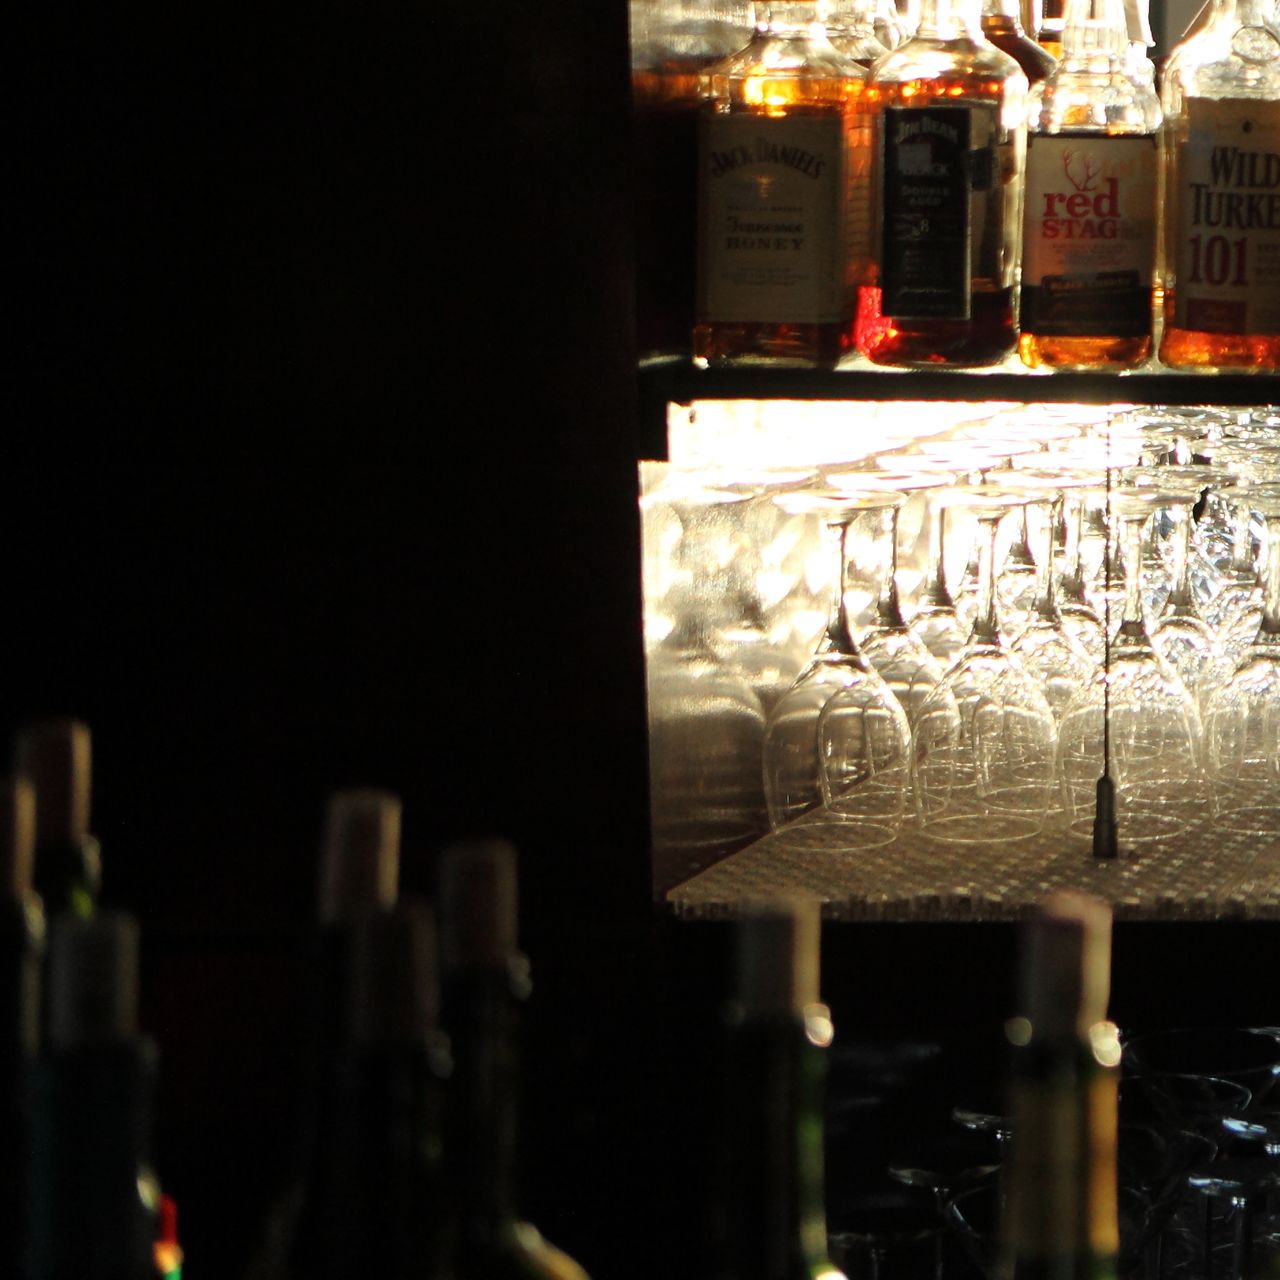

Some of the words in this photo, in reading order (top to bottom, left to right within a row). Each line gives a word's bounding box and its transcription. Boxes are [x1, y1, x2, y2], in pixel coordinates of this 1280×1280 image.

[1042, 177, 1122, 219] red
[724, 236, 804, 251] HONEY
[1041, 218, 1119, 240] STAG
[1187, 234, 1249, 287] 101
